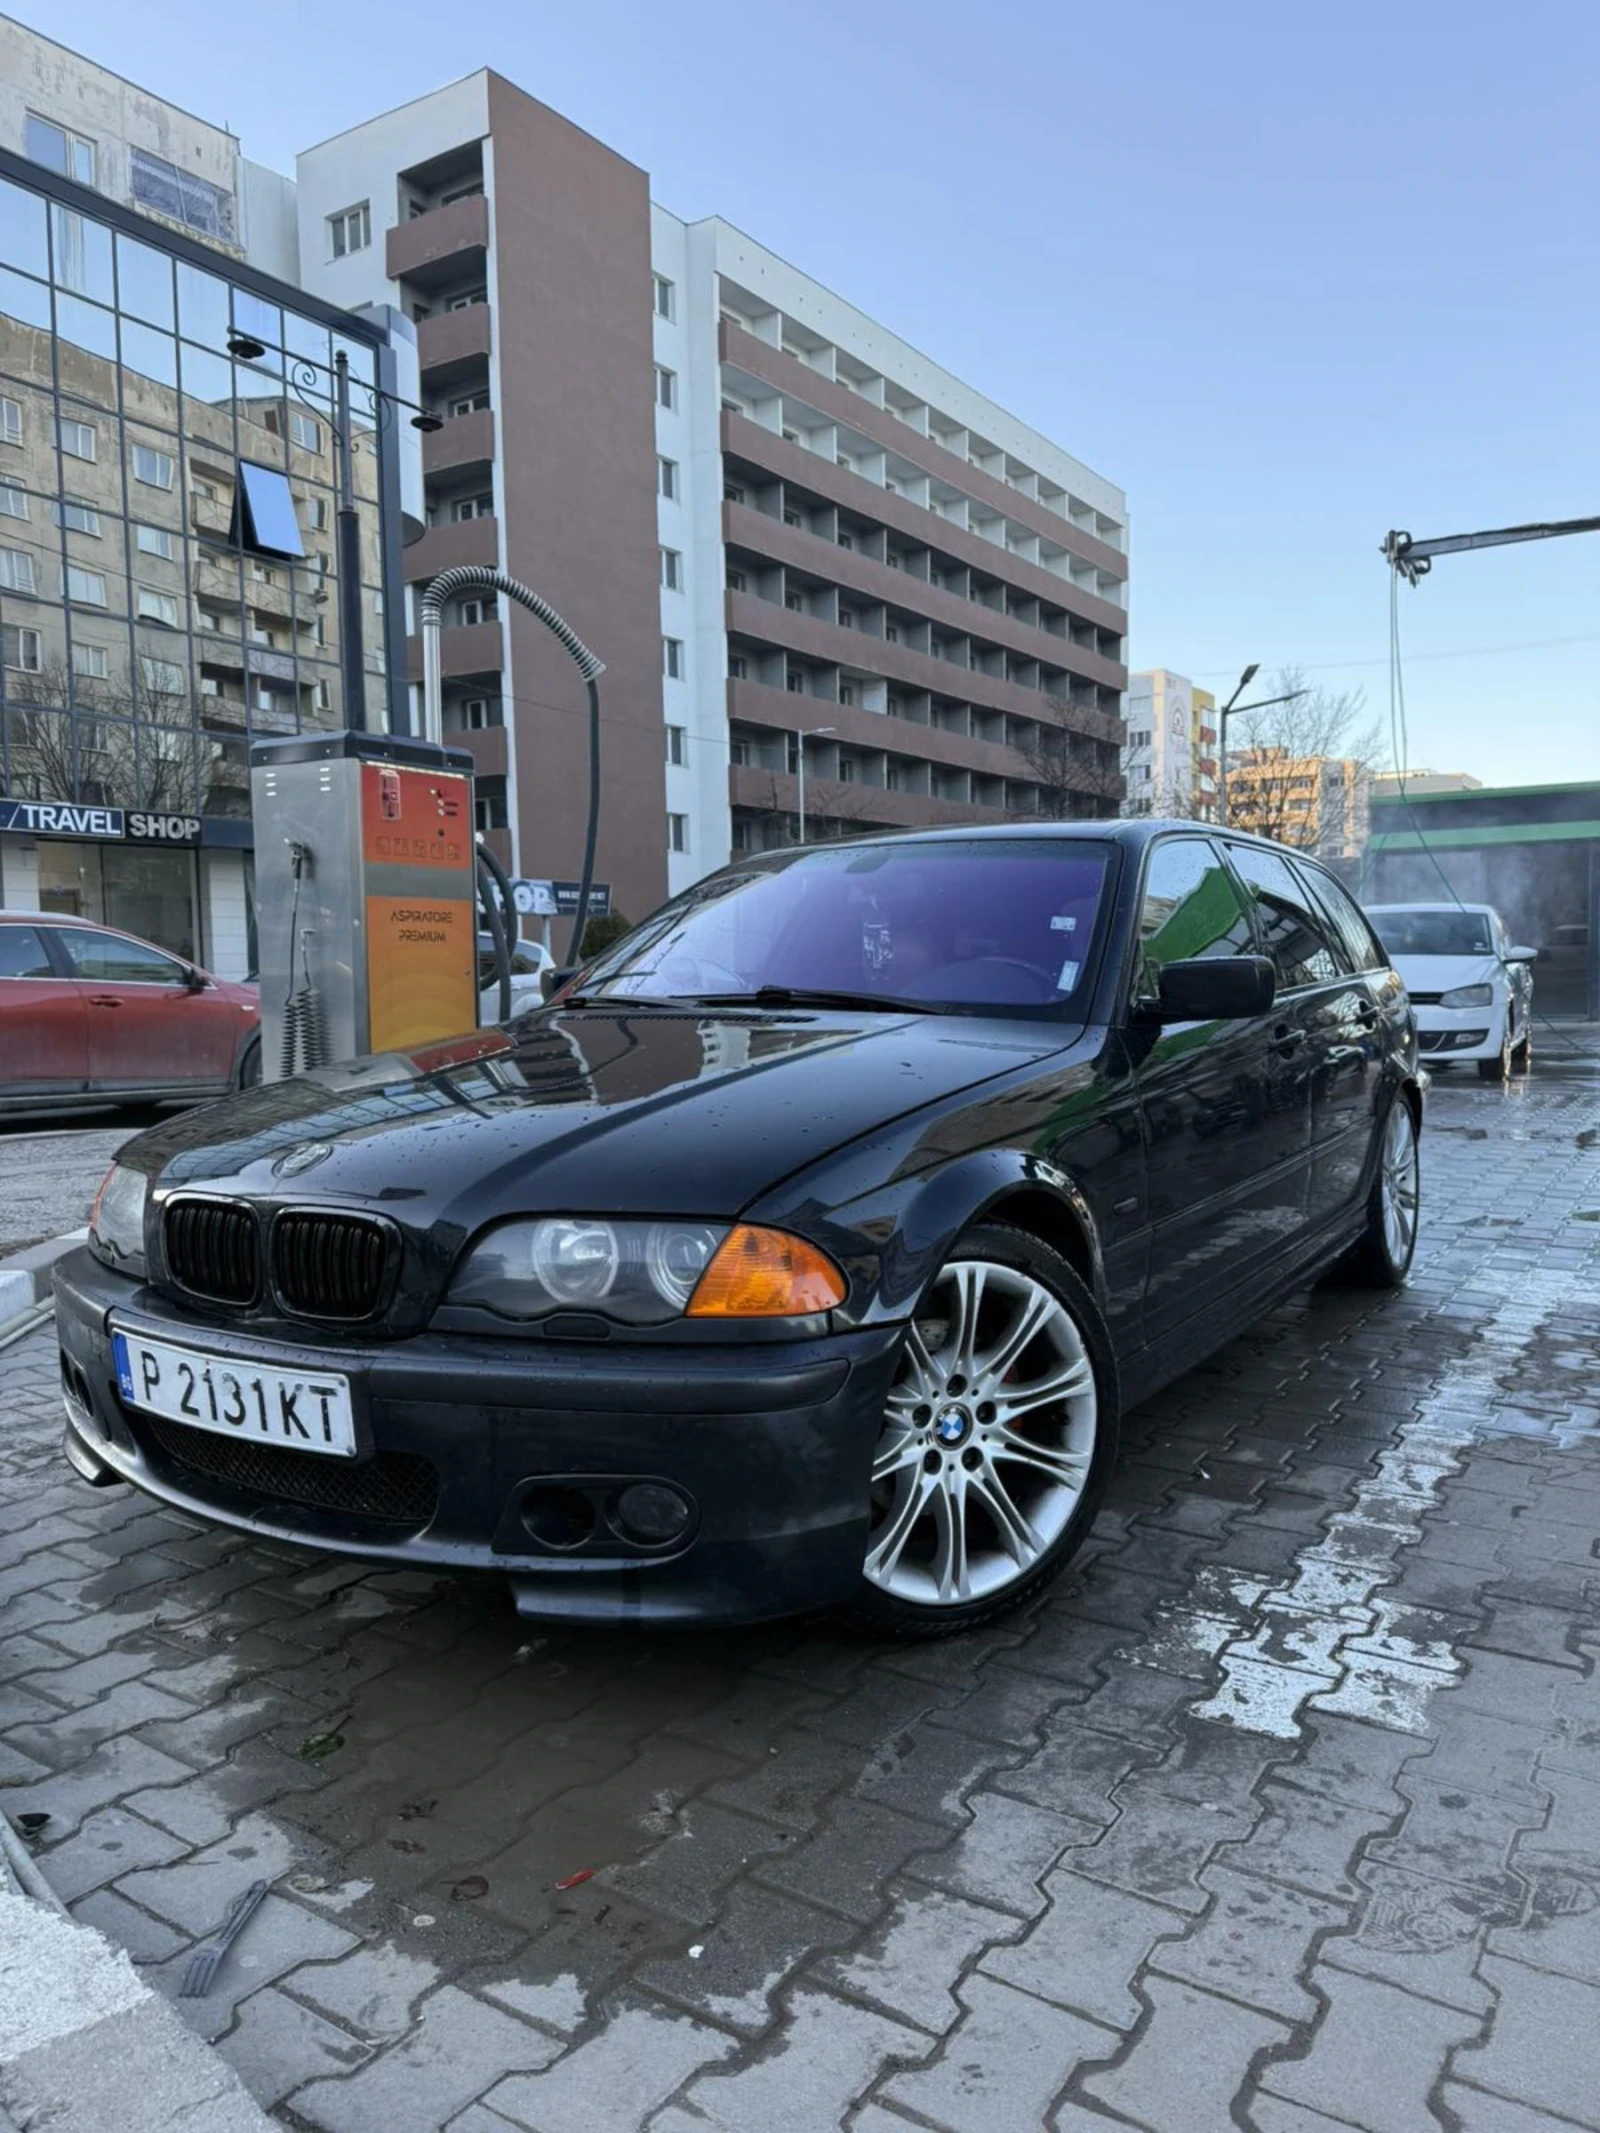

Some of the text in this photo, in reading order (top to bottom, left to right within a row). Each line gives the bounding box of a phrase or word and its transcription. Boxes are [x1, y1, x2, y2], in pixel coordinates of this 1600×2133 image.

[22, 804, 200, 840] TRAVEL SHOP
[391, 909, 454, 924] ASPIRATORE
[398, 929, 447, 943] PREMIUM
[141, 1350, 160, 1402] P
